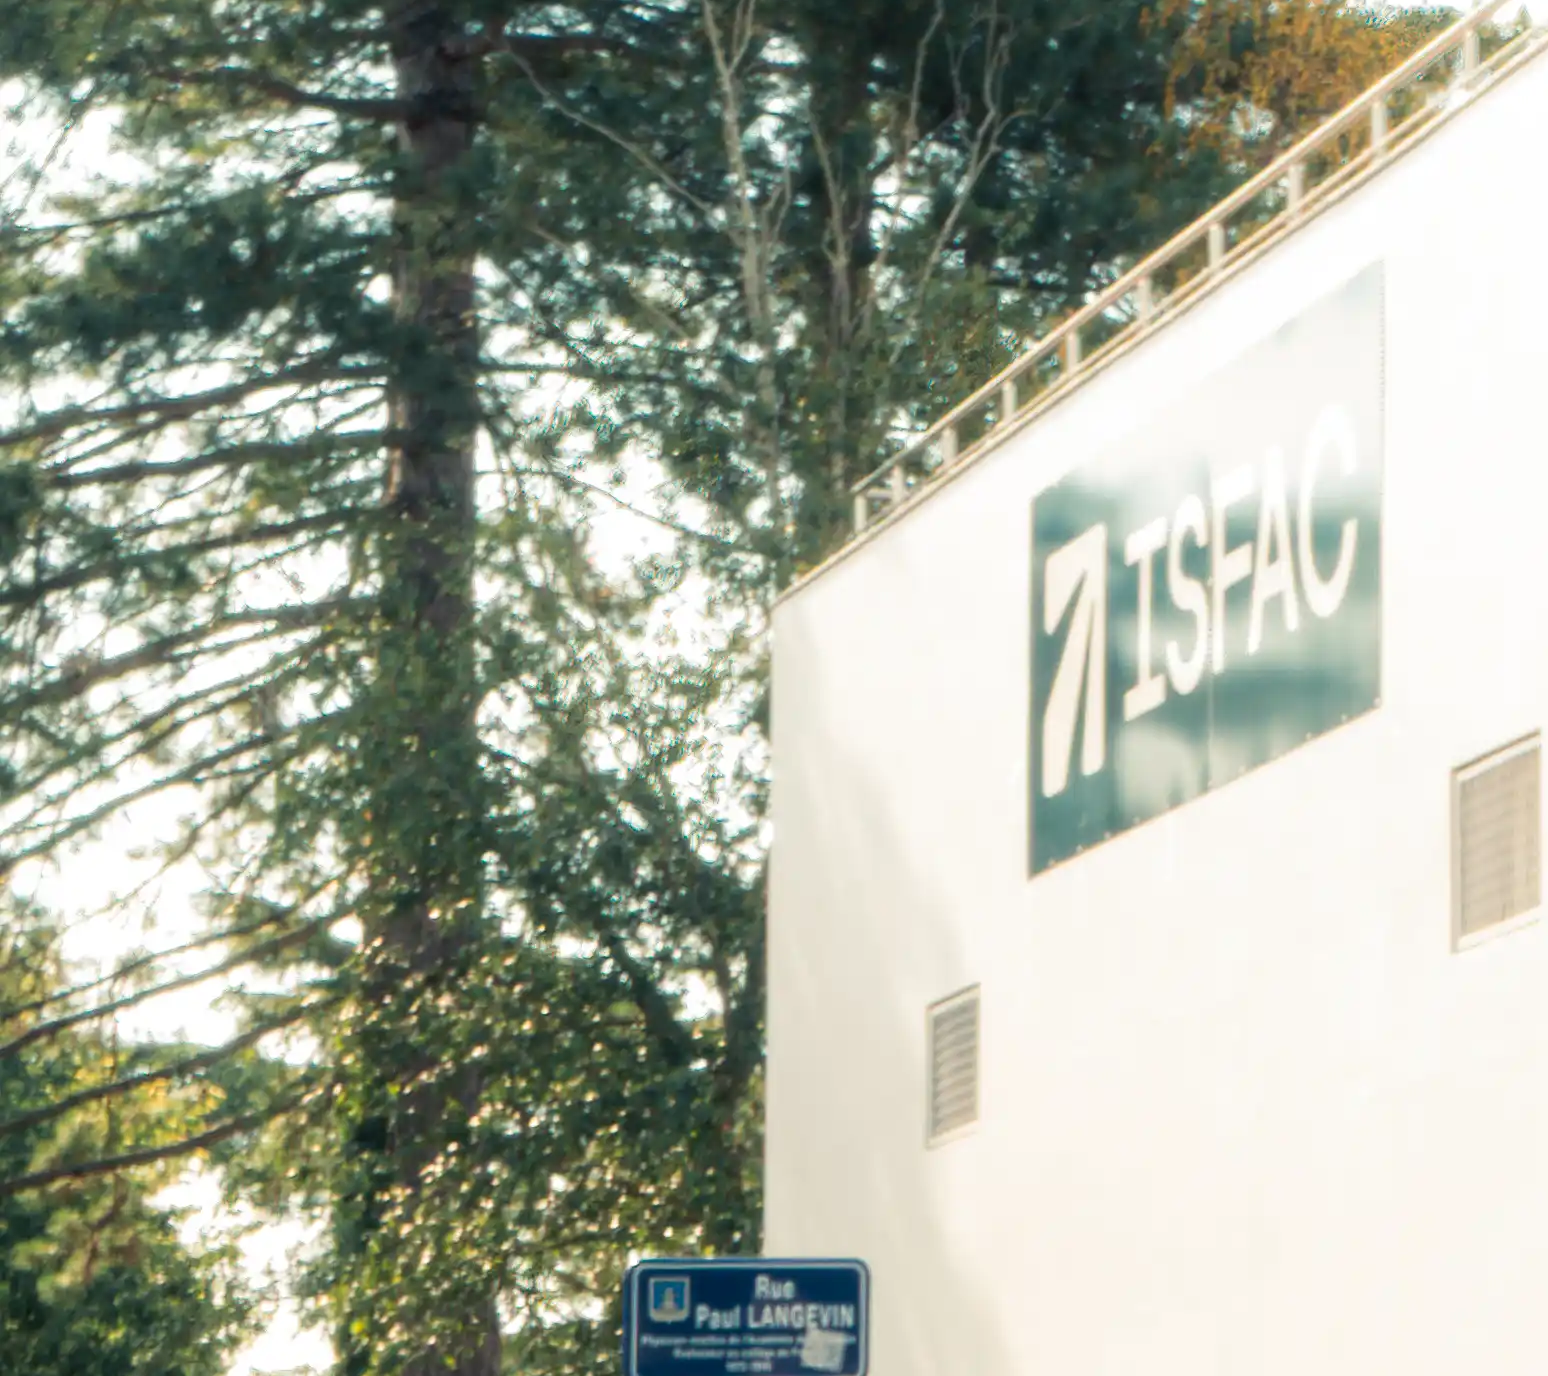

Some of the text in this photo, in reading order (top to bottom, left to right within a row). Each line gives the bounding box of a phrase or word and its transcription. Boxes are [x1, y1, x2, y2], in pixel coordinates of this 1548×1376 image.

[1122, 403, 1359, 723] ISFAC
[754, 1273, 796, 1300] Rue
[694, 1303, 856, 1329] Paul LANGEVIN
